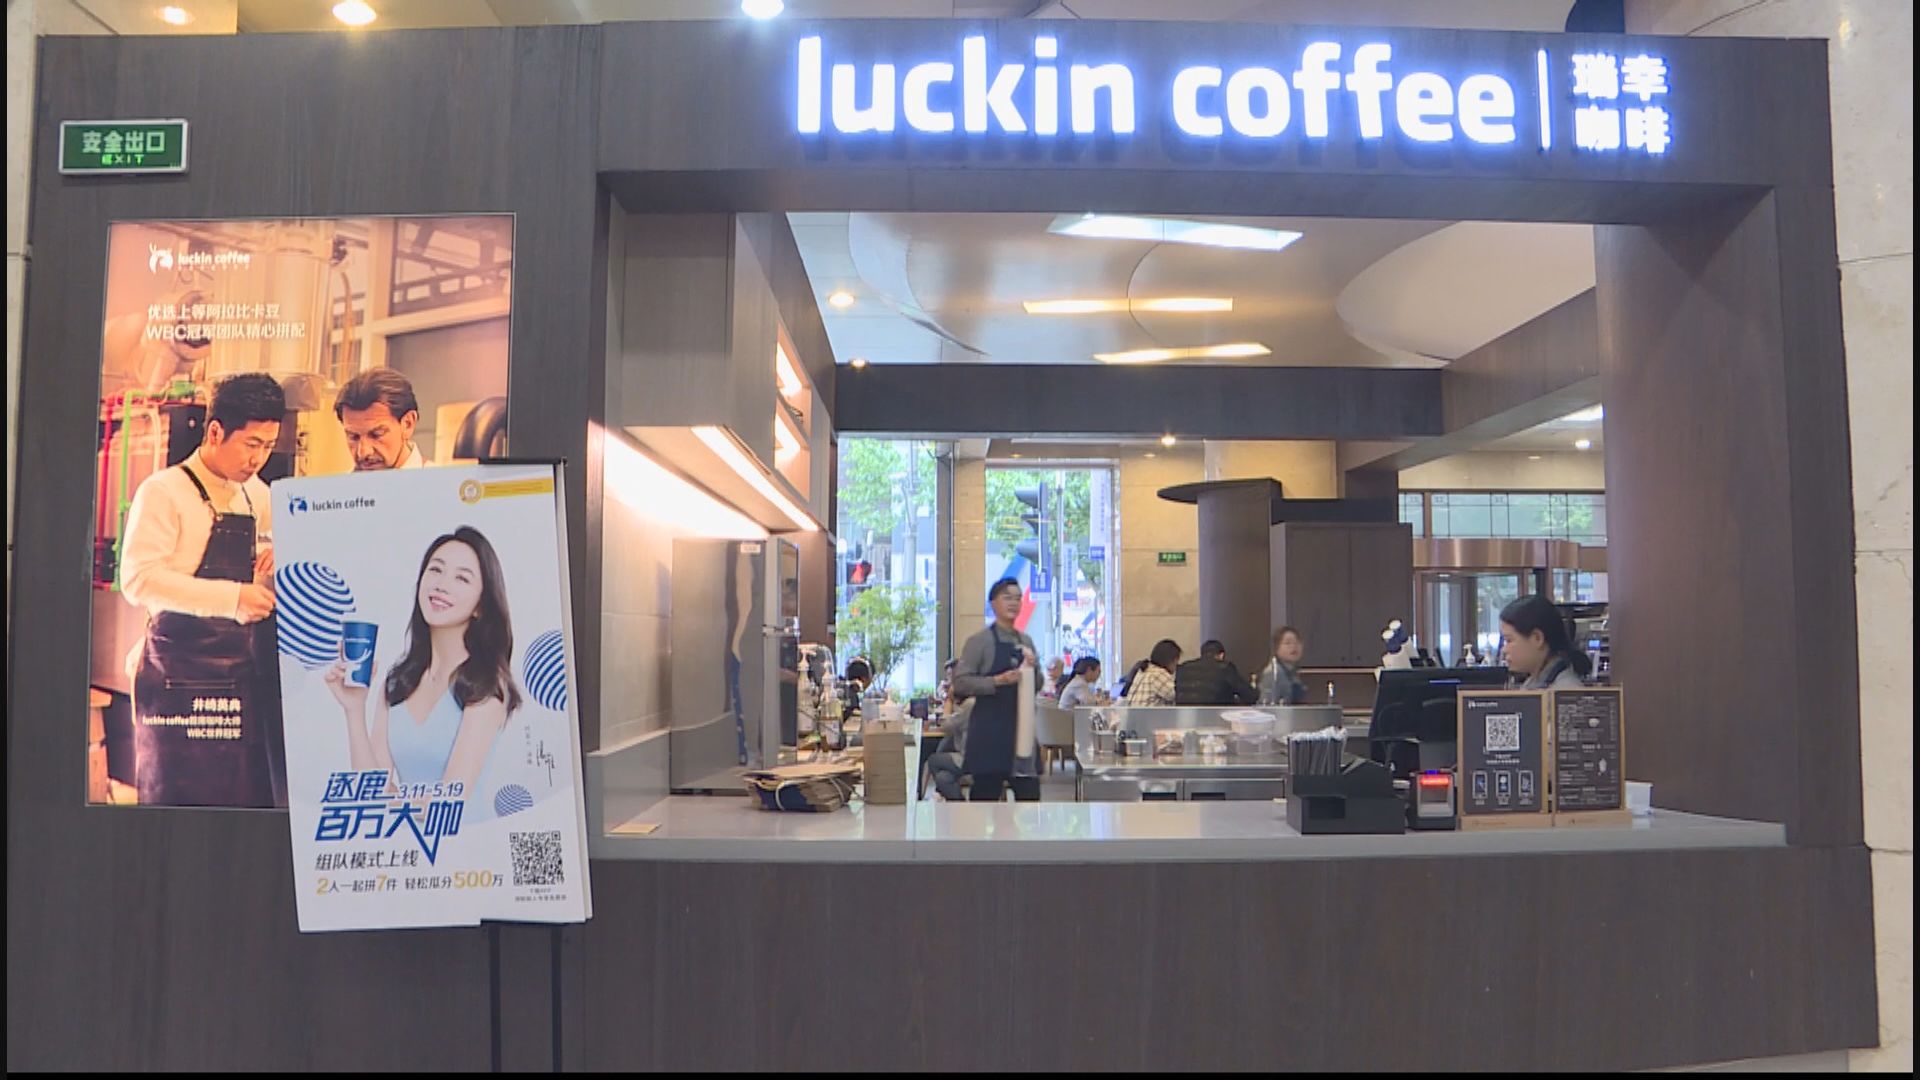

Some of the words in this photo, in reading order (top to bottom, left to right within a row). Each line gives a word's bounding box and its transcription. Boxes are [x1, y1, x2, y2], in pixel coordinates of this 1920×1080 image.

[1571, 53, 1668, 102] 瑞幸
[797, 36, 1136, 134] luckin
[1172, 41, 1516, 144] coffee
[1574, 104, 1671, 153] 咖啡
[82, 130, 165, 153] 安全出口
[177, 251, 212, 265] luckin
[214, 251, 250, 264] coffee
[147, 303, 280, 321] 优选上等阿拉比卡豆
[146, 321, 305, 341] WBC冠军团队精心拼配
[312, 499, 342, 512] luckin
[343, 497, 376, 510] coffee
[320, 770, 396, 803] 逐鹿
[397, 782, 464, 800] 3.11-5.19
[314, 800, 464, 866] 百万大咖
[315, 849, 420, 871] 组队模式上线
[316, 875, 398, 896] 2人一起拼7件
[404, 869, 504, 891] 轻松瓜分500万
